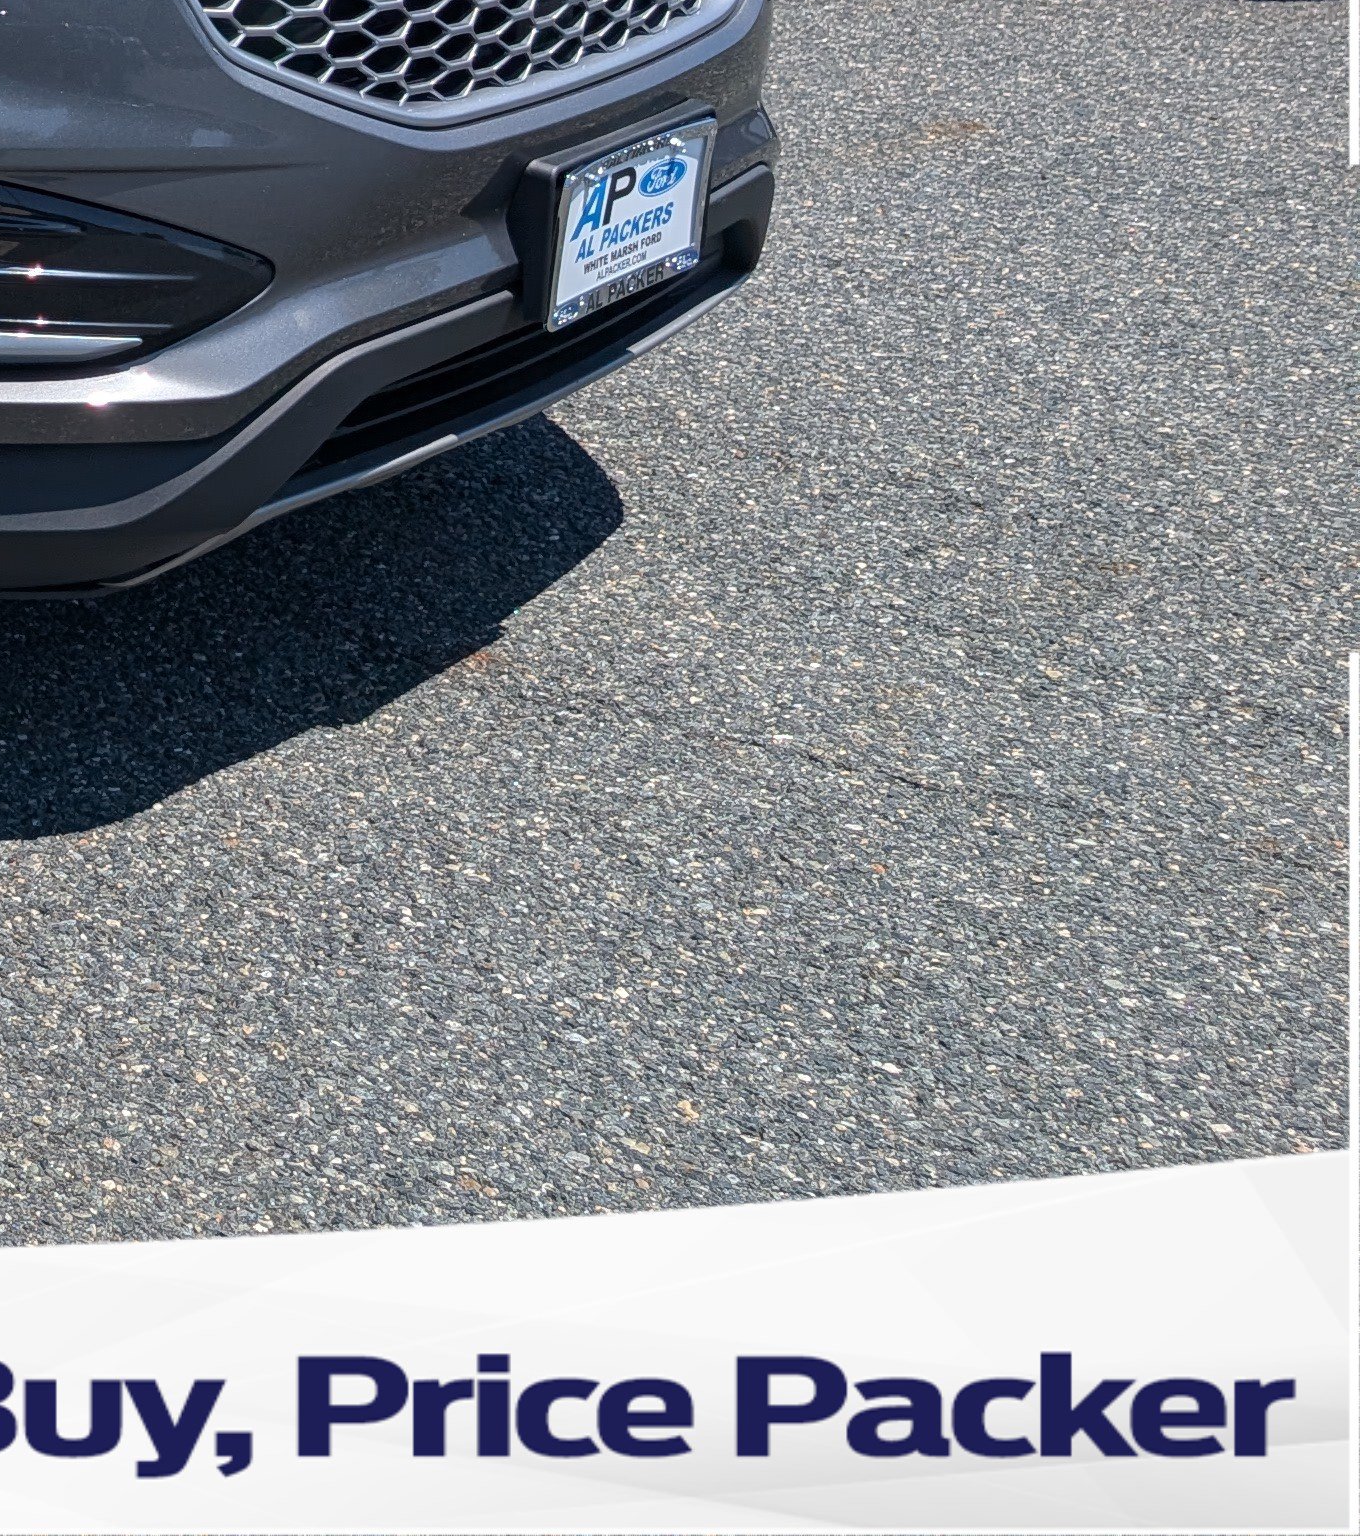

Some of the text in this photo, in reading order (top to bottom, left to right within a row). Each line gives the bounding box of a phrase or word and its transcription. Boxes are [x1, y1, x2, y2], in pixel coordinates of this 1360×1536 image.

[570, 164, 680, 243] AP Ford
[575, 201, 674, 263] AL PACKERS
[583, 231, 663, 275] WHITE MARSH FORD
[584, 291, 603, 314] AL
[608, 261, 665, 302] PACKER
